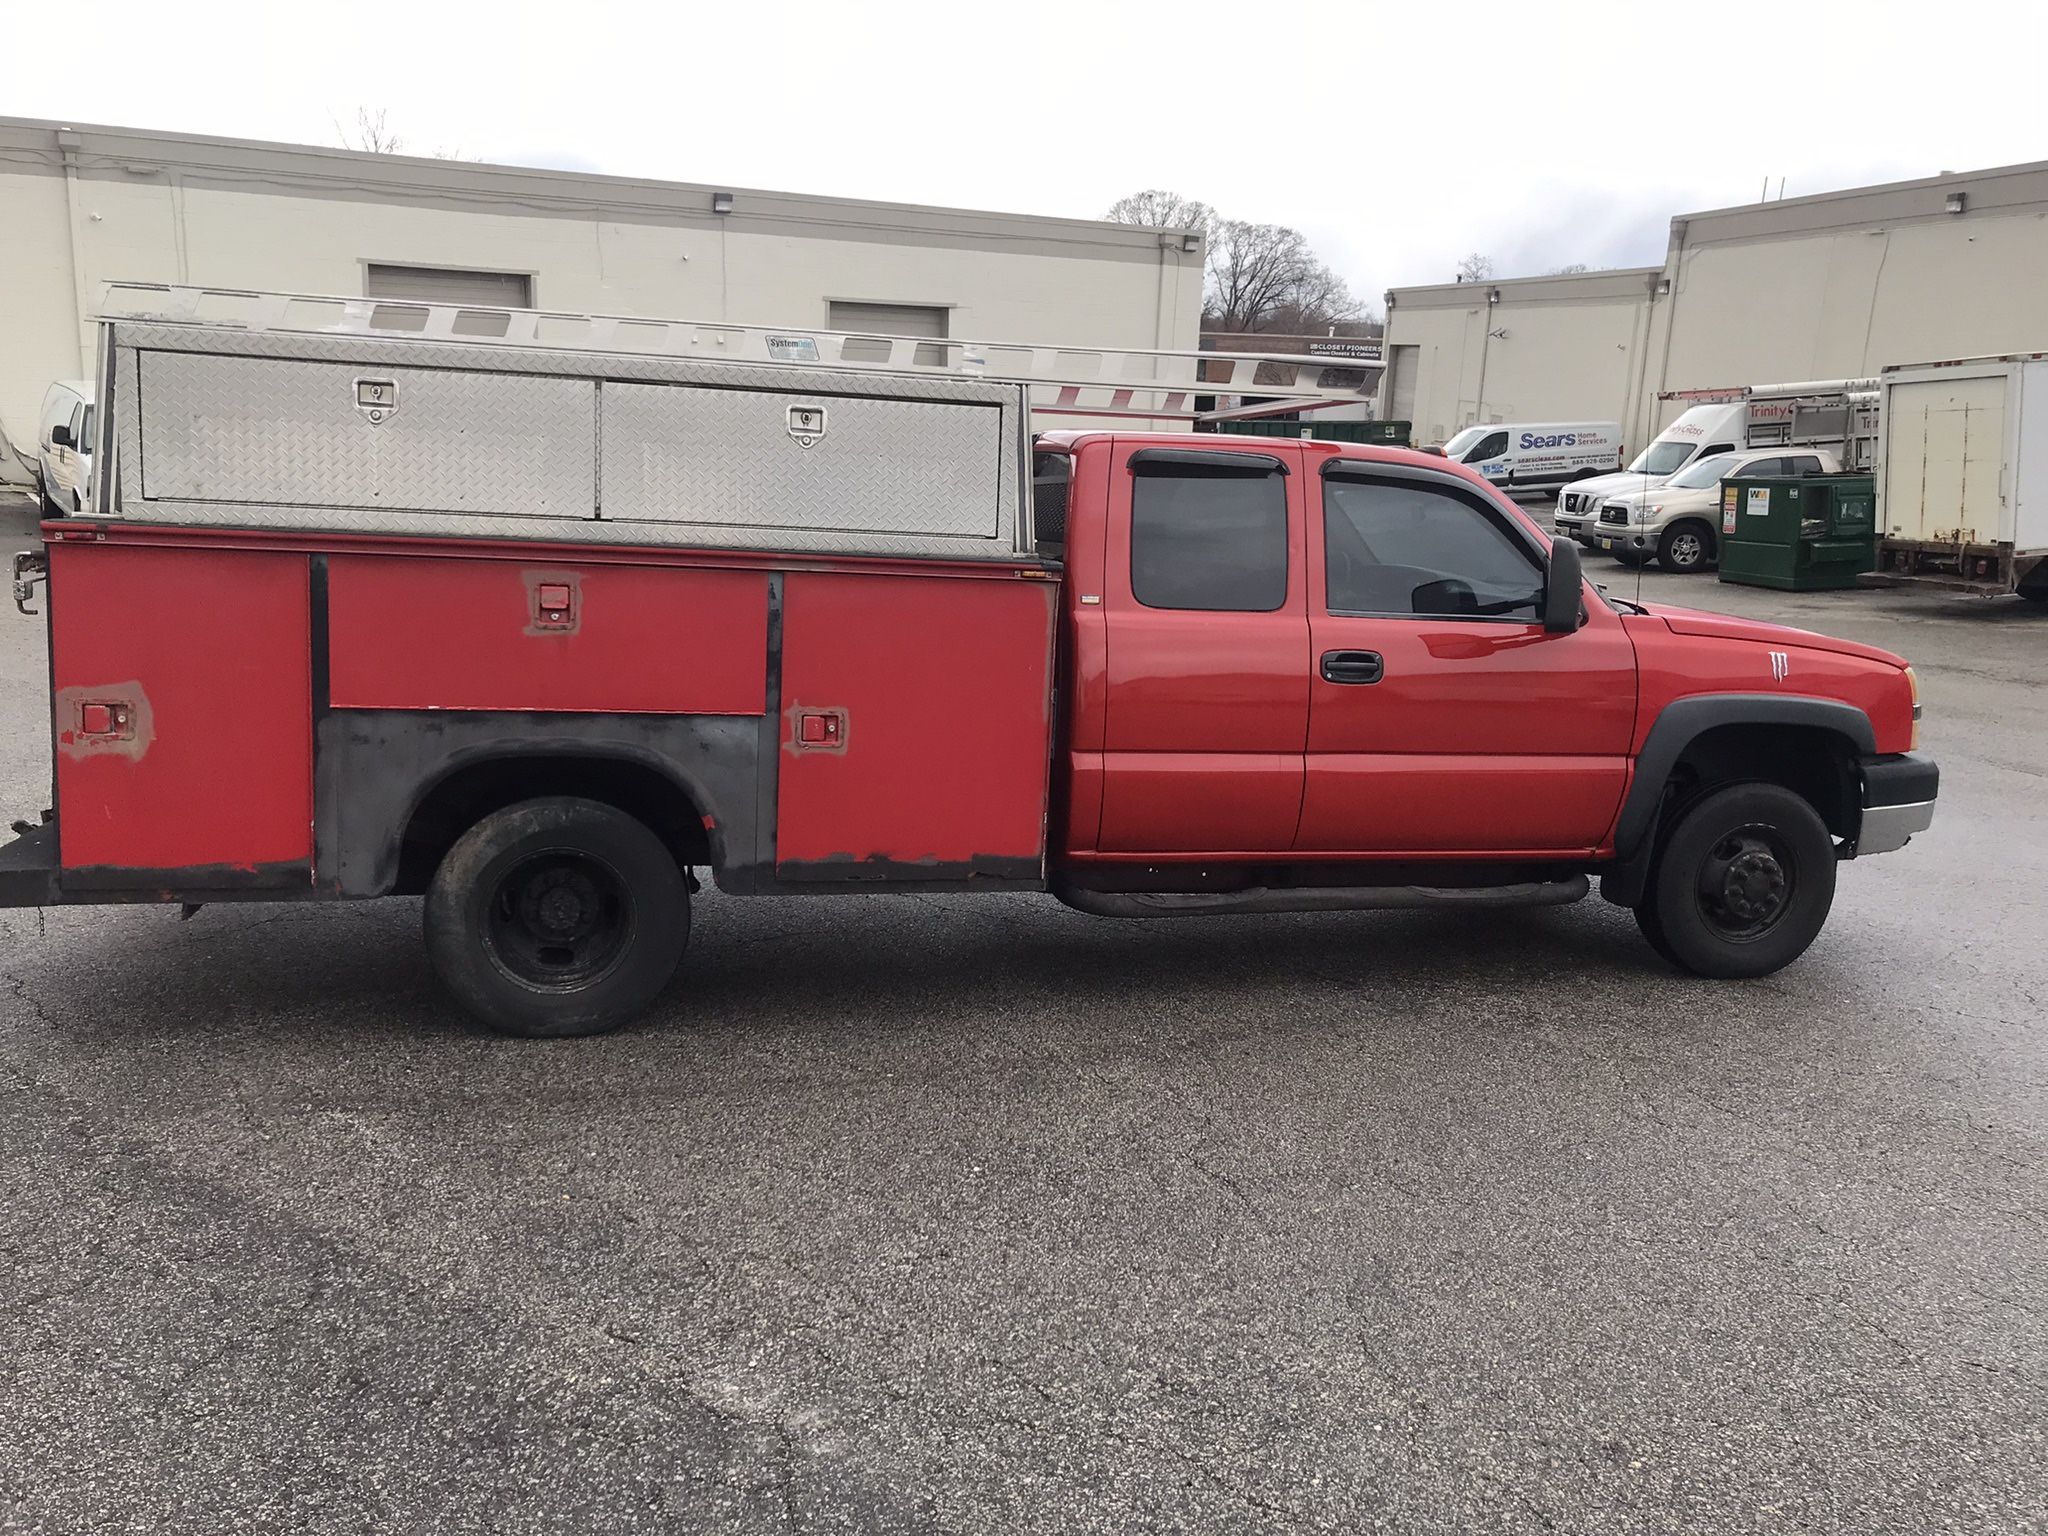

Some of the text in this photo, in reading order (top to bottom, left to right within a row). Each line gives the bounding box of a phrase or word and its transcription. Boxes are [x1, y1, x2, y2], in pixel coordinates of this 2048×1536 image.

[1750, 404, 1786, 419] Trinity
[1519, 432, 1576, 449] Sears
[1577, 438, 1608, 446] Services
